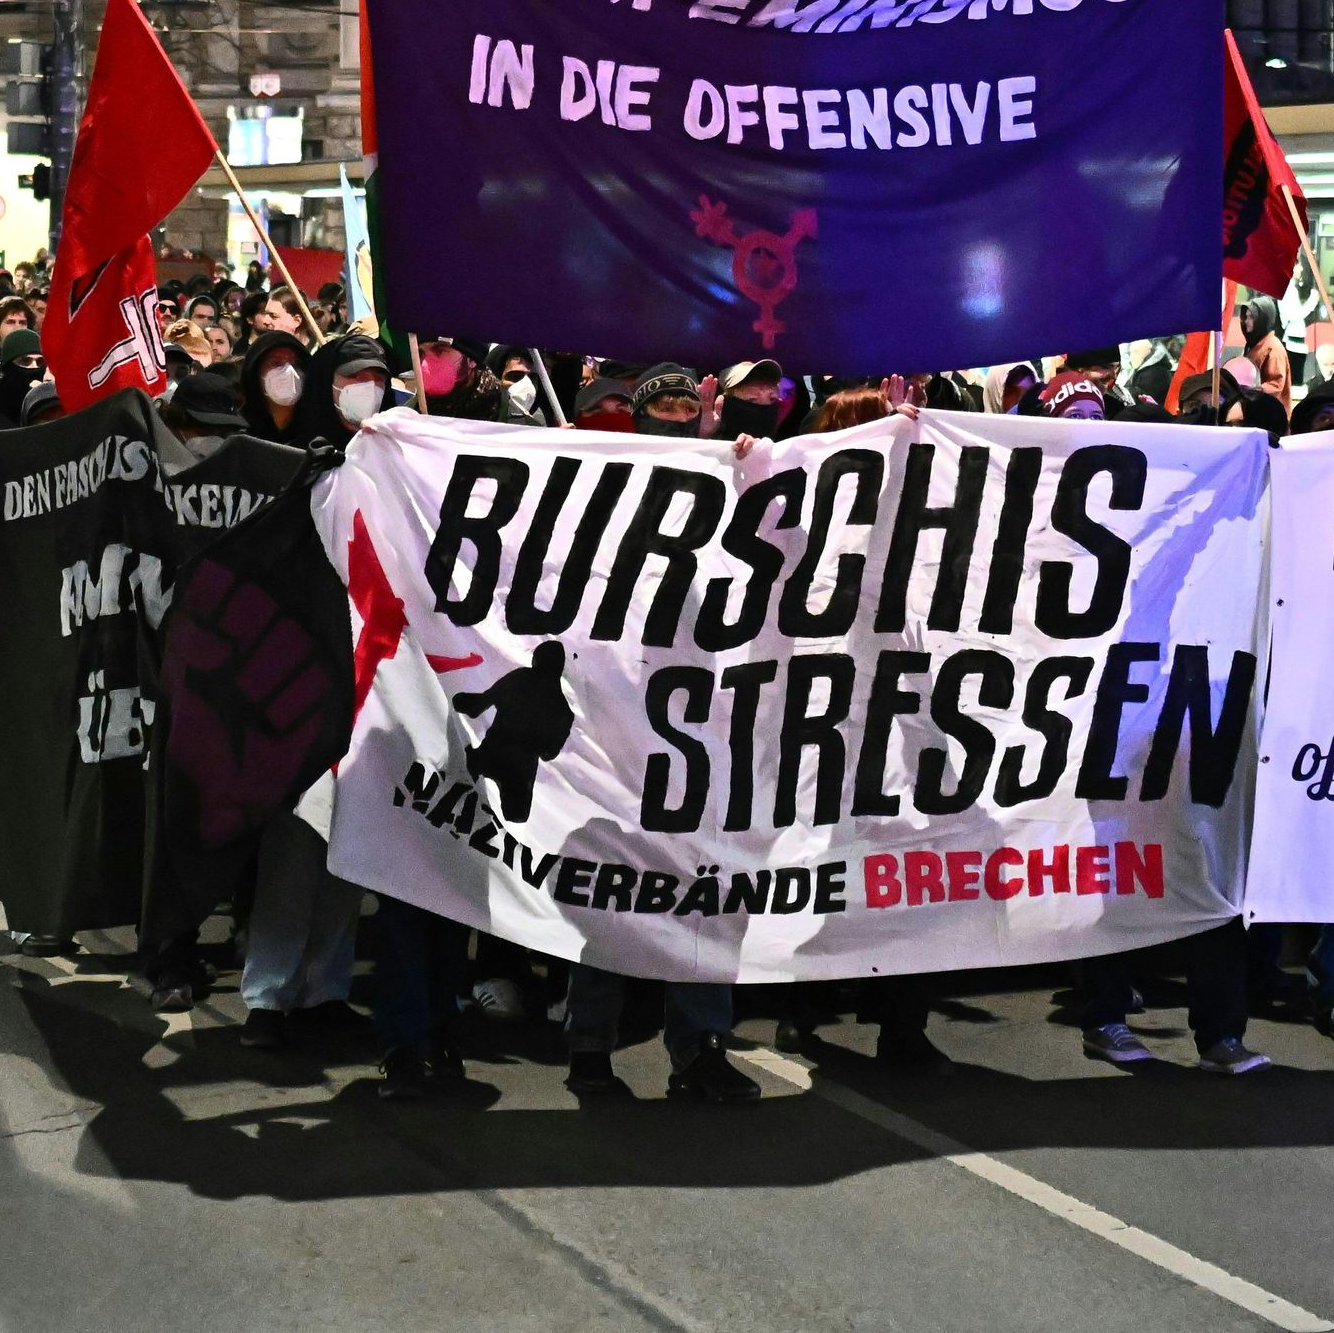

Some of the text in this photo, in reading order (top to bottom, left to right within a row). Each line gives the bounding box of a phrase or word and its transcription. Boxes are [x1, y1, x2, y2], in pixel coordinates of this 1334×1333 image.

[470, 34, 1037, 150] IN DIE OFFENSIVE
[4, 470, 51, 521] DEN
[426, 443, 1148, 653] BURSCHIS
[640, 642, 1258, 834] STRESSEN
[393, 761, 1165, 917] NAZIVERBÄNDE BRECHEN
